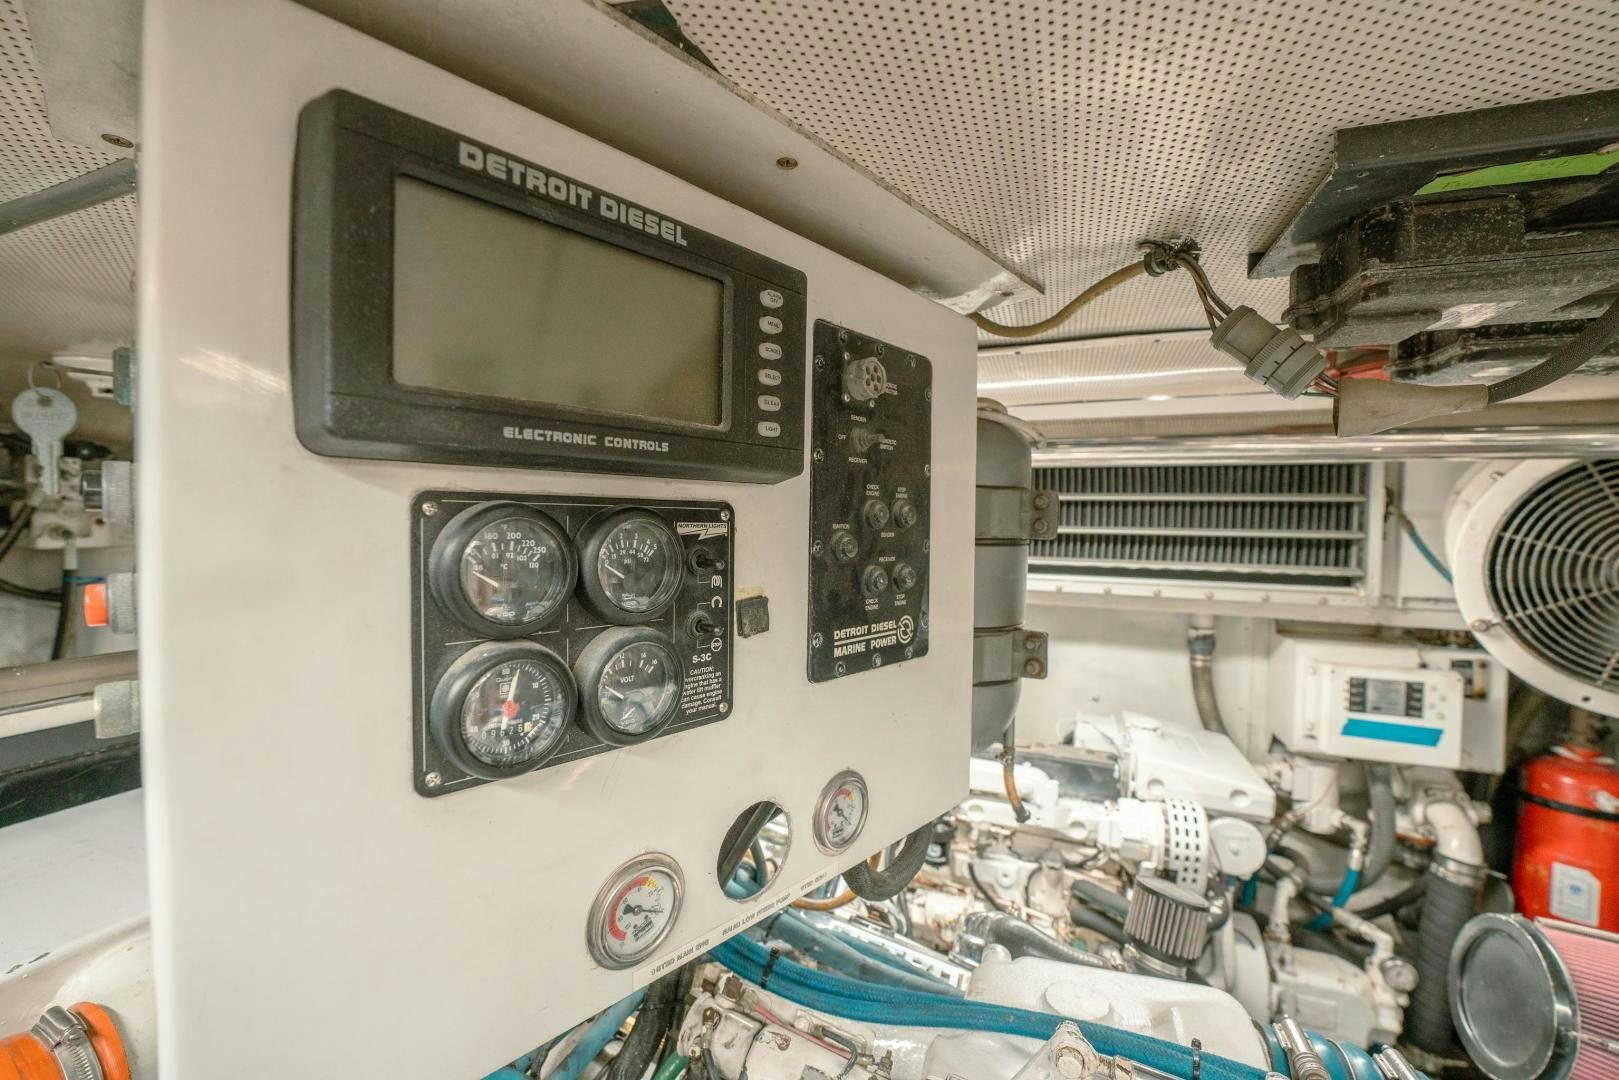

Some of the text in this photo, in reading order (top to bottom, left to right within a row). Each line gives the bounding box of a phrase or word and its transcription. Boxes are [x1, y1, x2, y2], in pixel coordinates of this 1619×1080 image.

[458, 141, 688, 247] DETROIT DIESEL
[503, 426, 670, 452] ELECTRONIC CONTROLS
[506, 531, 522, 540] 200
[533, 546, 547, 554] 250
[833, 619, 897, 640] DETROIT DIESEL
[833, 635, 897, 658] MARINE POWER
[691, 652, 713, 664] S-3C
[620, 674, 636, 684] VOLT
[684, 673, 714, 683] vercranking
